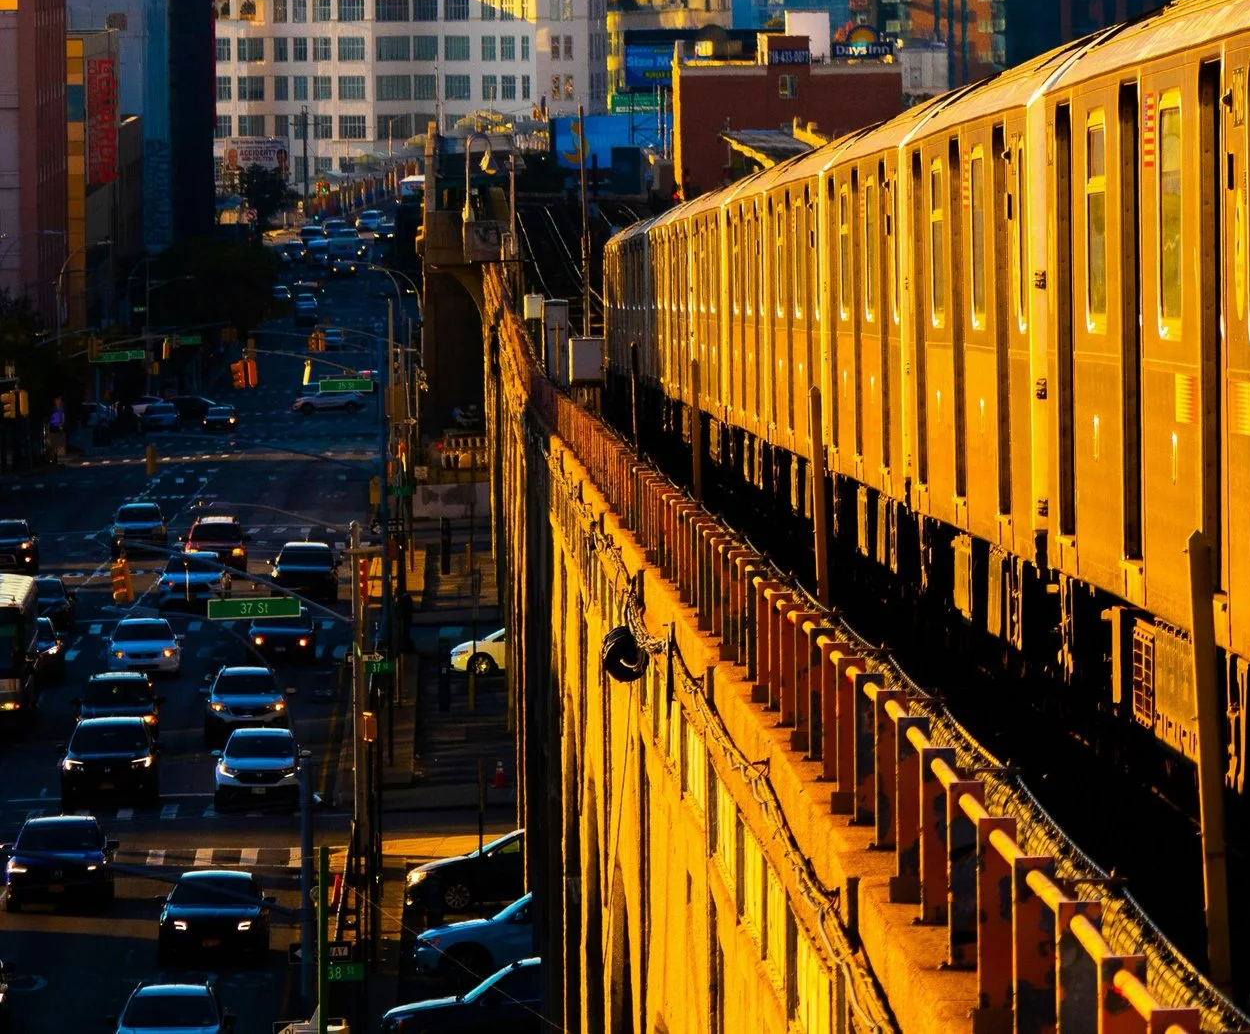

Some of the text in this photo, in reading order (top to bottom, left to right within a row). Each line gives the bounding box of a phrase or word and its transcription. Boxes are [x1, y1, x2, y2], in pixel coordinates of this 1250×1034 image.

[836, 45, 890, 56] Days Inn
[240, 602, 269, 614] 37 St
[371, 663, 381, 673] 37
[327, 967, 342, 979] 38
